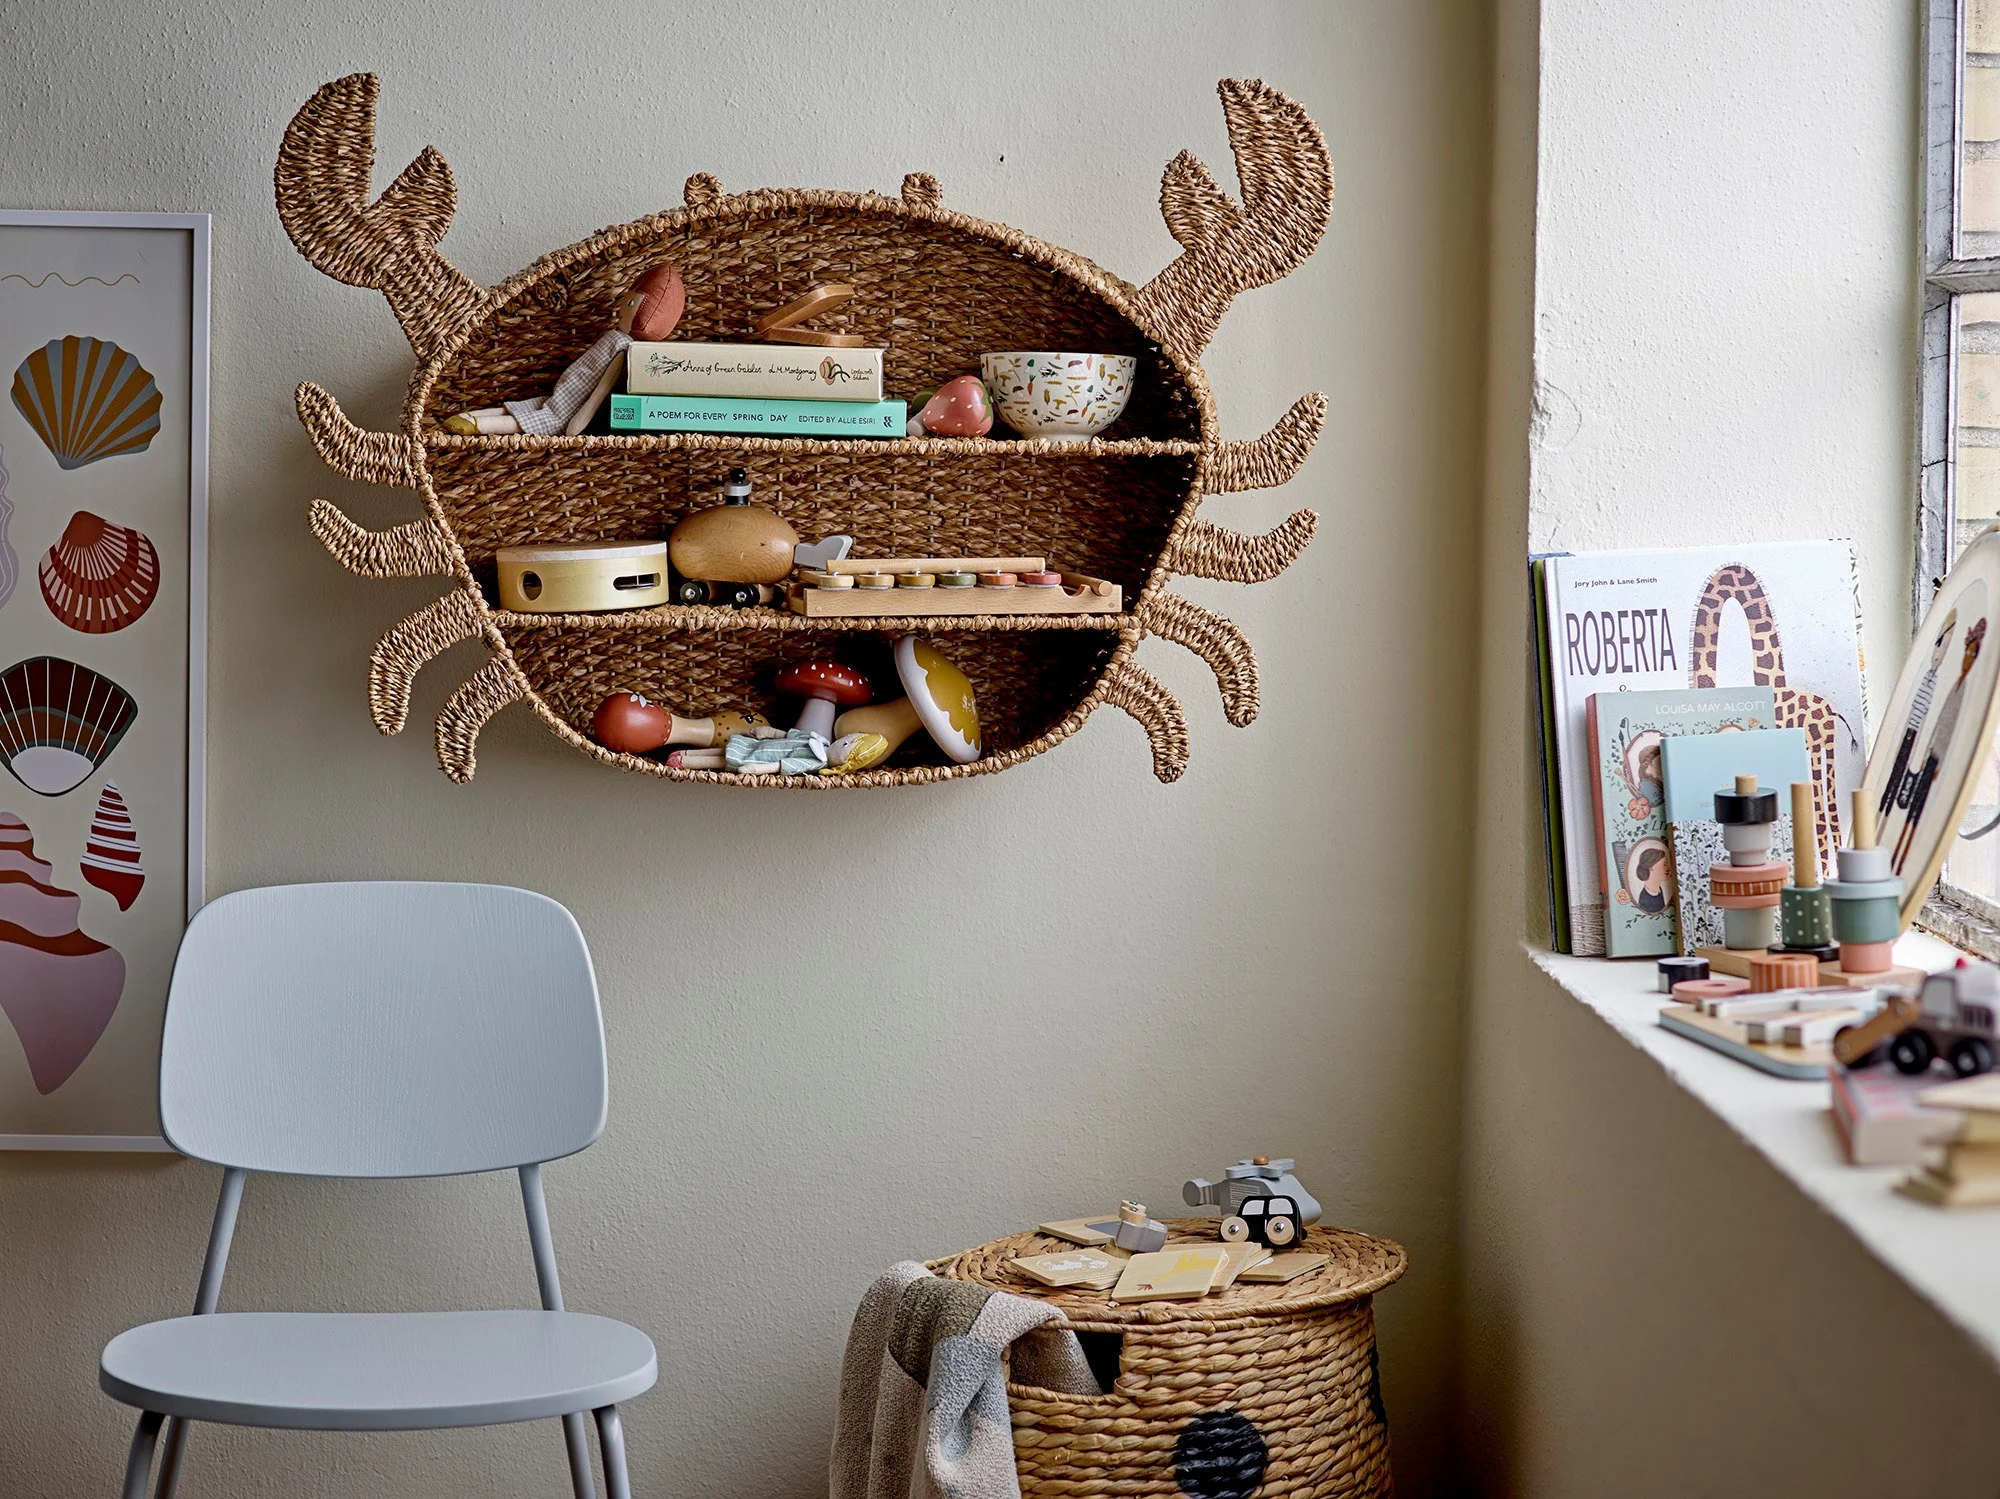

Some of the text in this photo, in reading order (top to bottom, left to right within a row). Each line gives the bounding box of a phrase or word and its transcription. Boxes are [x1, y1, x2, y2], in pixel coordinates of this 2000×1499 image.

[682, 359, 763, 376] Anne of Green Gables
[784, 366, 817, 382] Montgomery
[648, 411, 788, 422] A POEM FOR EVERY SPRING DAY
[798, 415, 825, 423] EDITED
[825, 416, 836, 424] BY
[837, 417, 857, 425] ALLIE
[1565, 608, 1678, 676] ROBERTA
[1655, 700, 1767, 715] LOUISA MAY ALCOTT
